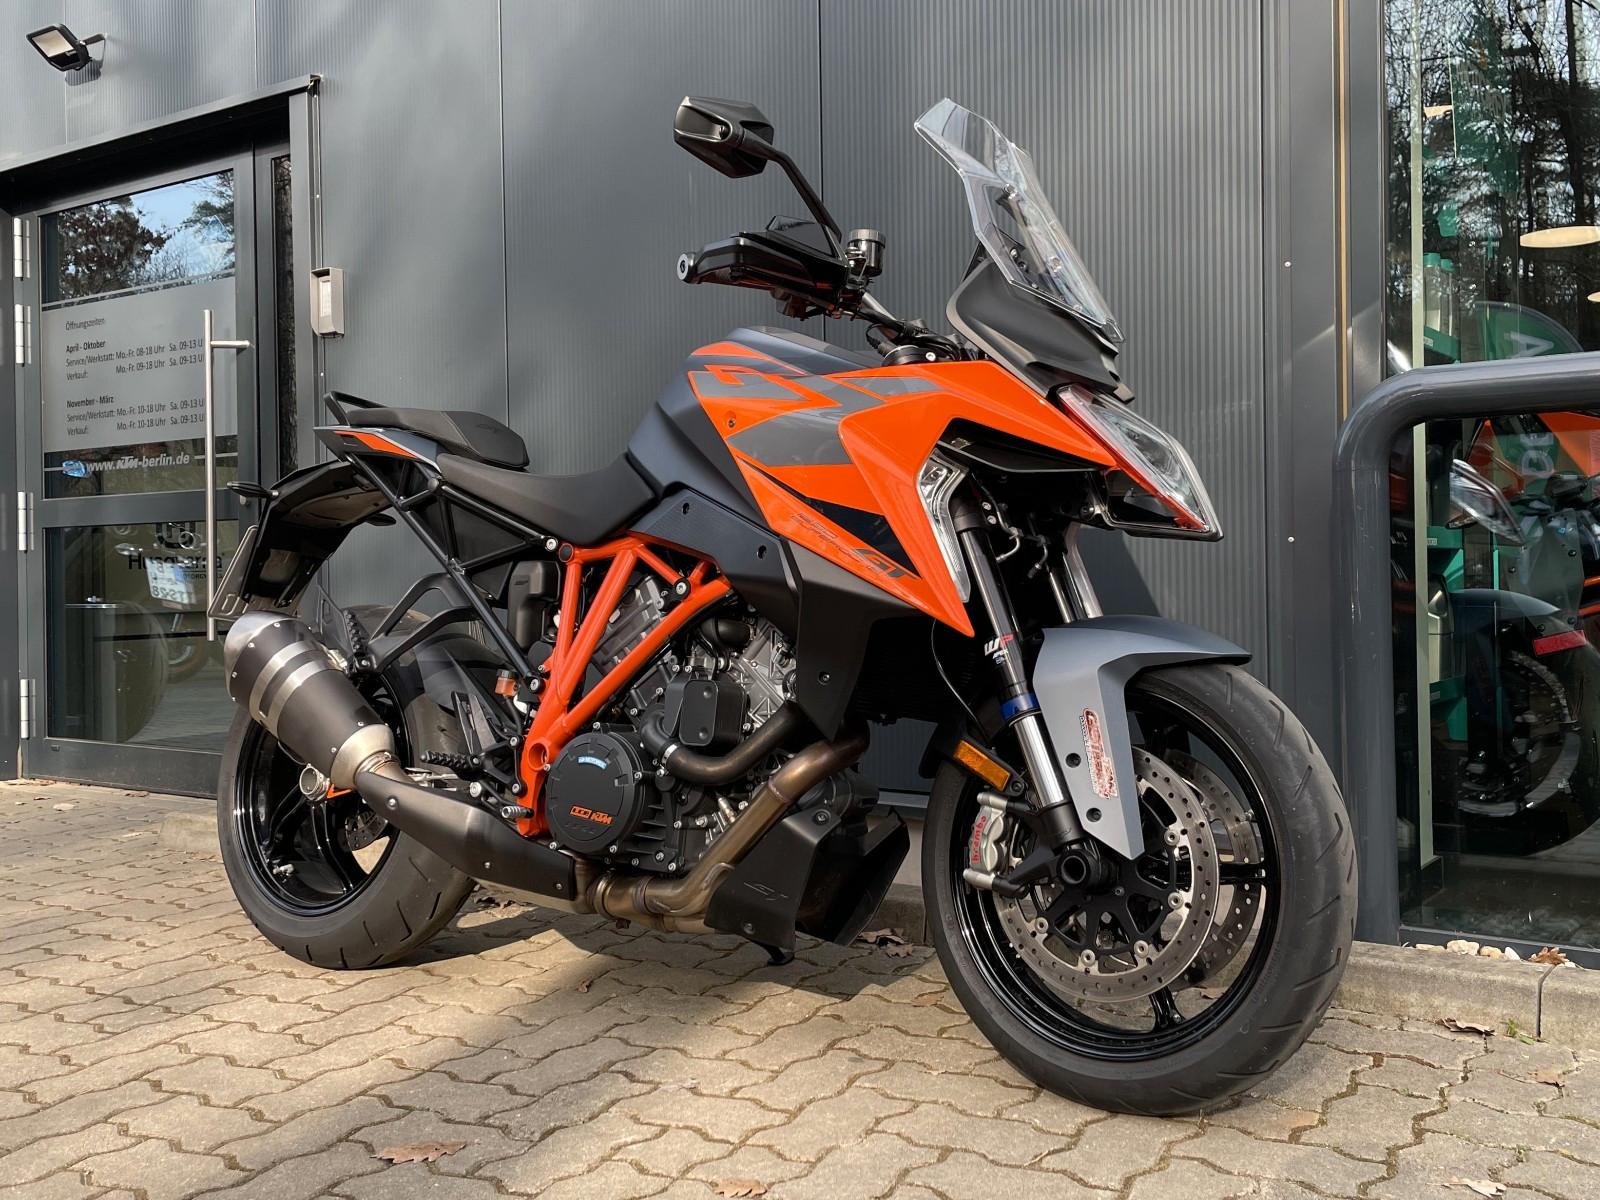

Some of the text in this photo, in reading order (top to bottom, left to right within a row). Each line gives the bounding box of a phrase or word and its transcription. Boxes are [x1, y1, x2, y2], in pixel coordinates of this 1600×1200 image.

[66, 319, 105, 330] Öffnungszeiten
[66, 343, 79, 353] April
[83, 340, 106, 350] Oktober
[66, 353, 115, 367] Service/Werkstatt:
[136, 346, 152, 356] 08-18
[154, 345, 165, 353] Uhr
[180, 340, 196, 350] 09-13
[67, 371, 88, 380] Verkauf:
[136, 360, 152, 370] 09-18
[154, 359, 165, 368] Uhr
[180, 354, 196, 365] 09-13
[67, 397, 95, 408] November
[100, 395, 114, 404] März
[67, 409, 115, 422] Service/Werkstatt:
[138, 404, 153, 414] 10-18
[155, 403, 166, 412] Uhr
[180, 399, 197, 409] 09-13
[67, 425, 89, 436] Verkauf:
[138, 418, 153, 428] 10-18
[155, 418, 166, 426] Uhr
[181, 414, 197, 424] 09-13
[971, 816, 987, 864] brembo
